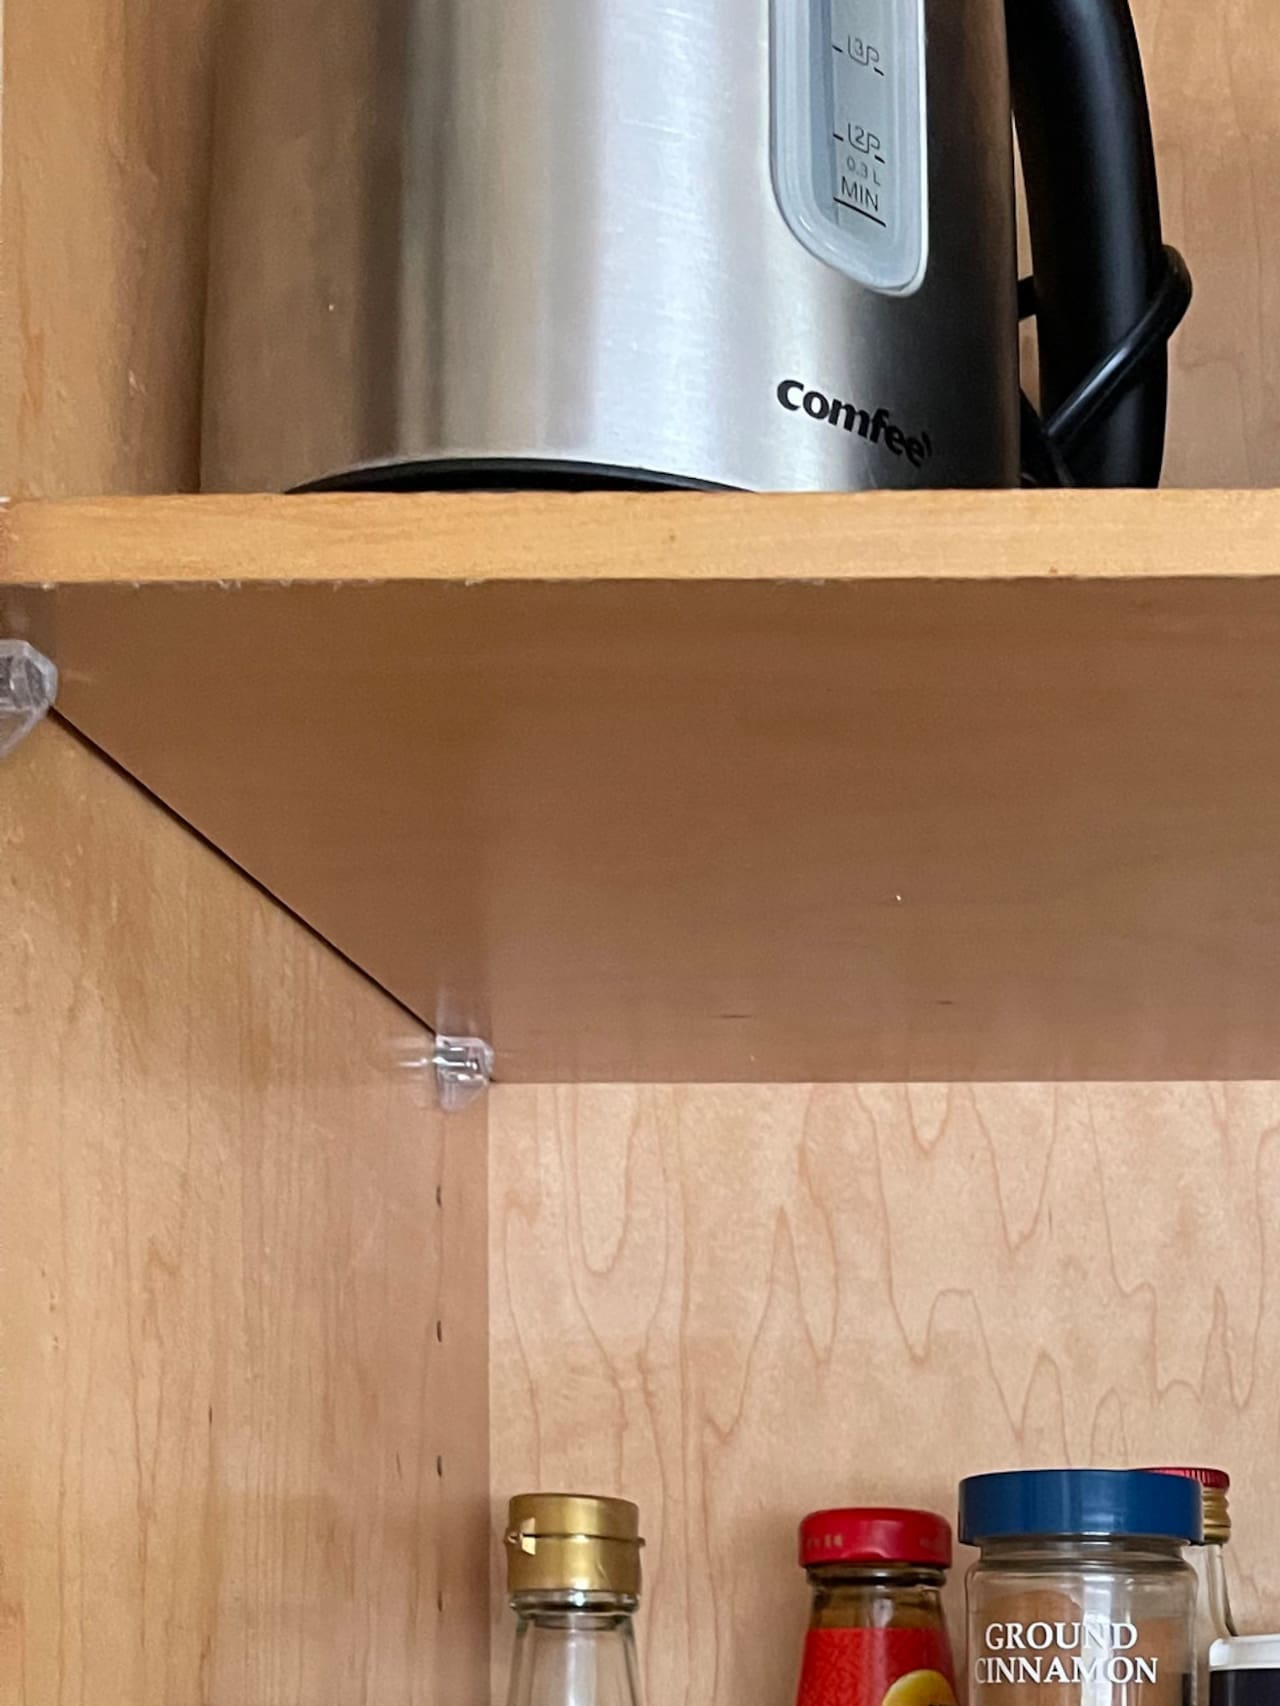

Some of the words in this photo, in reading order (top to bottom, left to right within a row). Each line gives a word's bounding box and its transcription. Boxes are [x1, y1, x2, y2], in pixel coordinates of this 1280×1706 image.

[846, 156, 868, 179] 0.3
[841, 175, 878, 212] MIN
[985, 1622, 1138, 1650] GROUND
[974, 1656, 1158, 1684] CINNAMON
